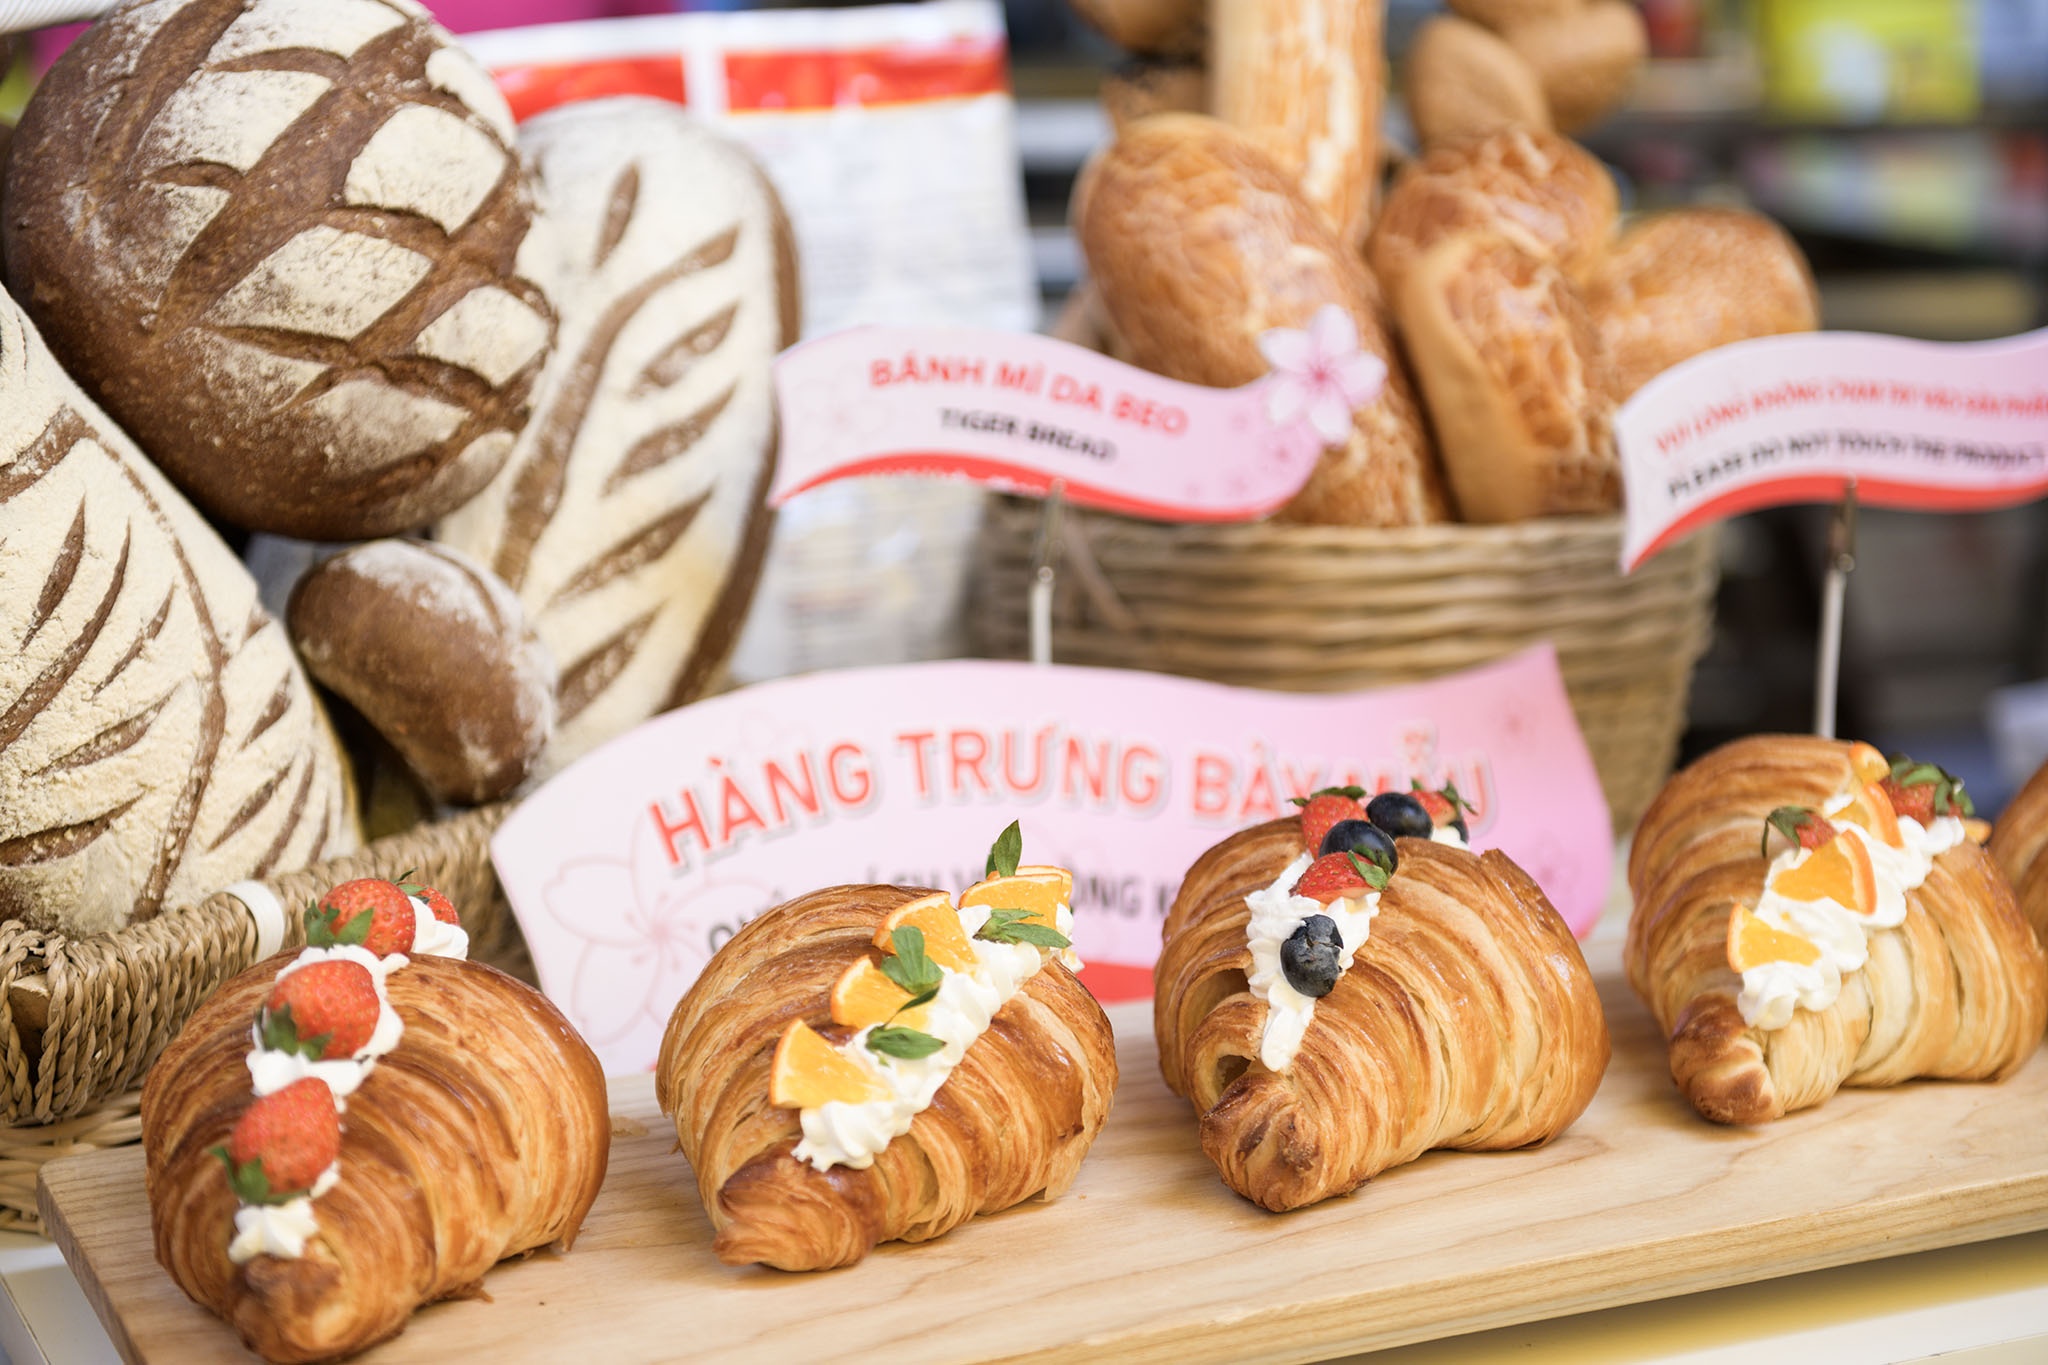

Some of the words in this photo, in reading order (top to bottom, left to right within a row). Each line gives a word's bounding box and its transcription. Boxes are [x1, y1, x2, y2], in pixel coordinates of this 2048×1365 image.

[870, 351, 983, 388] BÁNH
[1049, 373, 1103, 412] DA
[1112, 391, 1189, 437] BEO
[938, 406, 1020, 436] TIGER
[1025, 420, 1119, 463] BREAD
[1668, 450, 1745, 501] PLEASE
[1750, 436, 1785, 466] DO
[1788, 427, 1834, 454] NOT
[648, 740, 873, 868] HÀNG
[896, 724, 1164, 810] TRƯNG
